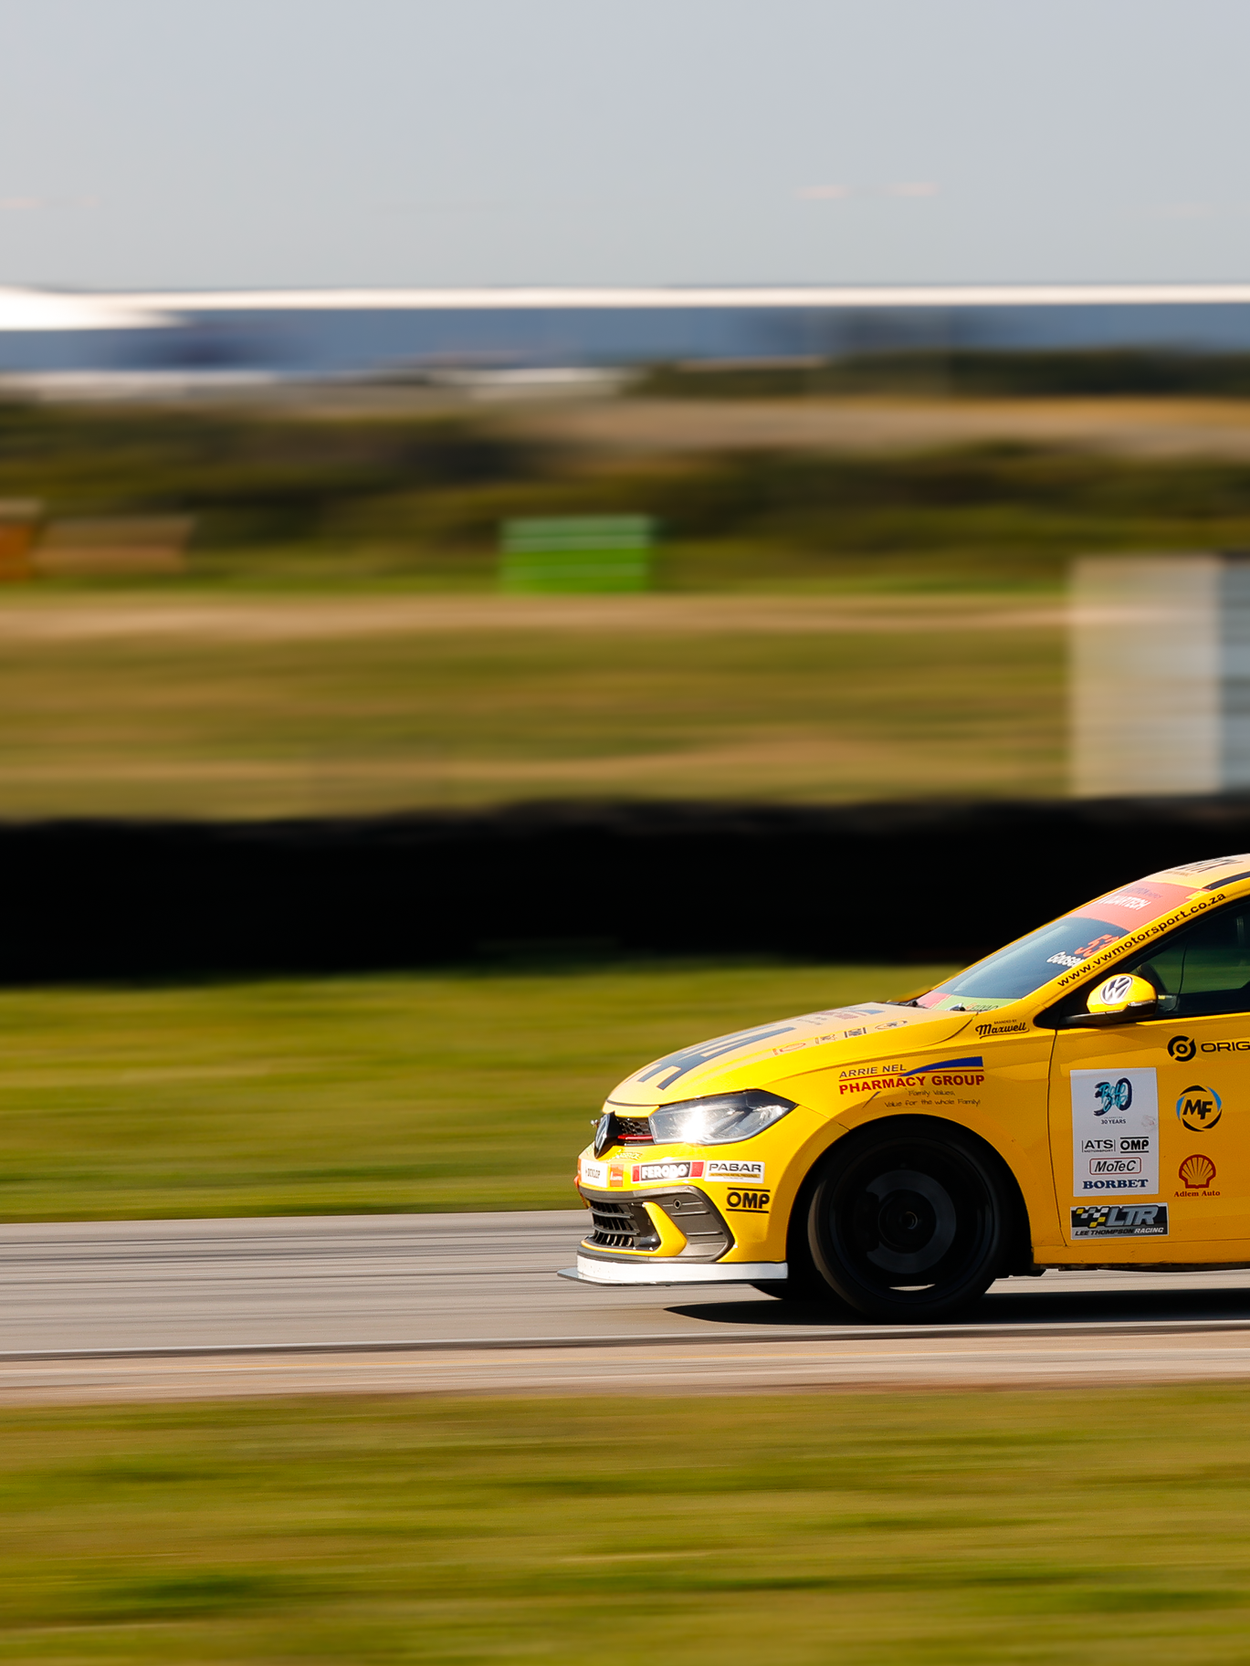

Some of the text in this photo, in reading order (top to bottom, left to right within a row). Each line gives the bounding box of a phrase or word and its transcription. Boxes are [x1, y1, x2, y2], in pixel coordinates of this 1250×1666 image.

[1057, 892, 1226, 987] www.vwmotorsport.co.za
[1046, 951, 1085, 968] Goose
[975, 1022, 1029, 1037] Maxwell
[839, 1064, 906, 1079] ARRIE NEL
[839, 1074, 985, 1095] PHARMACY GROUP
[1182, 1099, 1213, 1120] MF
[1084, 1139, 1114, 1150] ATS
[1120, 1140, 1149, 1151] OMP
[642, 1164, 685, 1179] FERODO
[709, 1163, 761, 1172] PABAR
[1094, 1160, 1136, 1173] MoTeC
[1082, 1179, 1149, 1190] BORBET
[726, 1192, 770, 1209] OMP
[1106, 1206, 1159, 1226] LTR
[1090, 1228, 1134, 1236] THOMPSON
